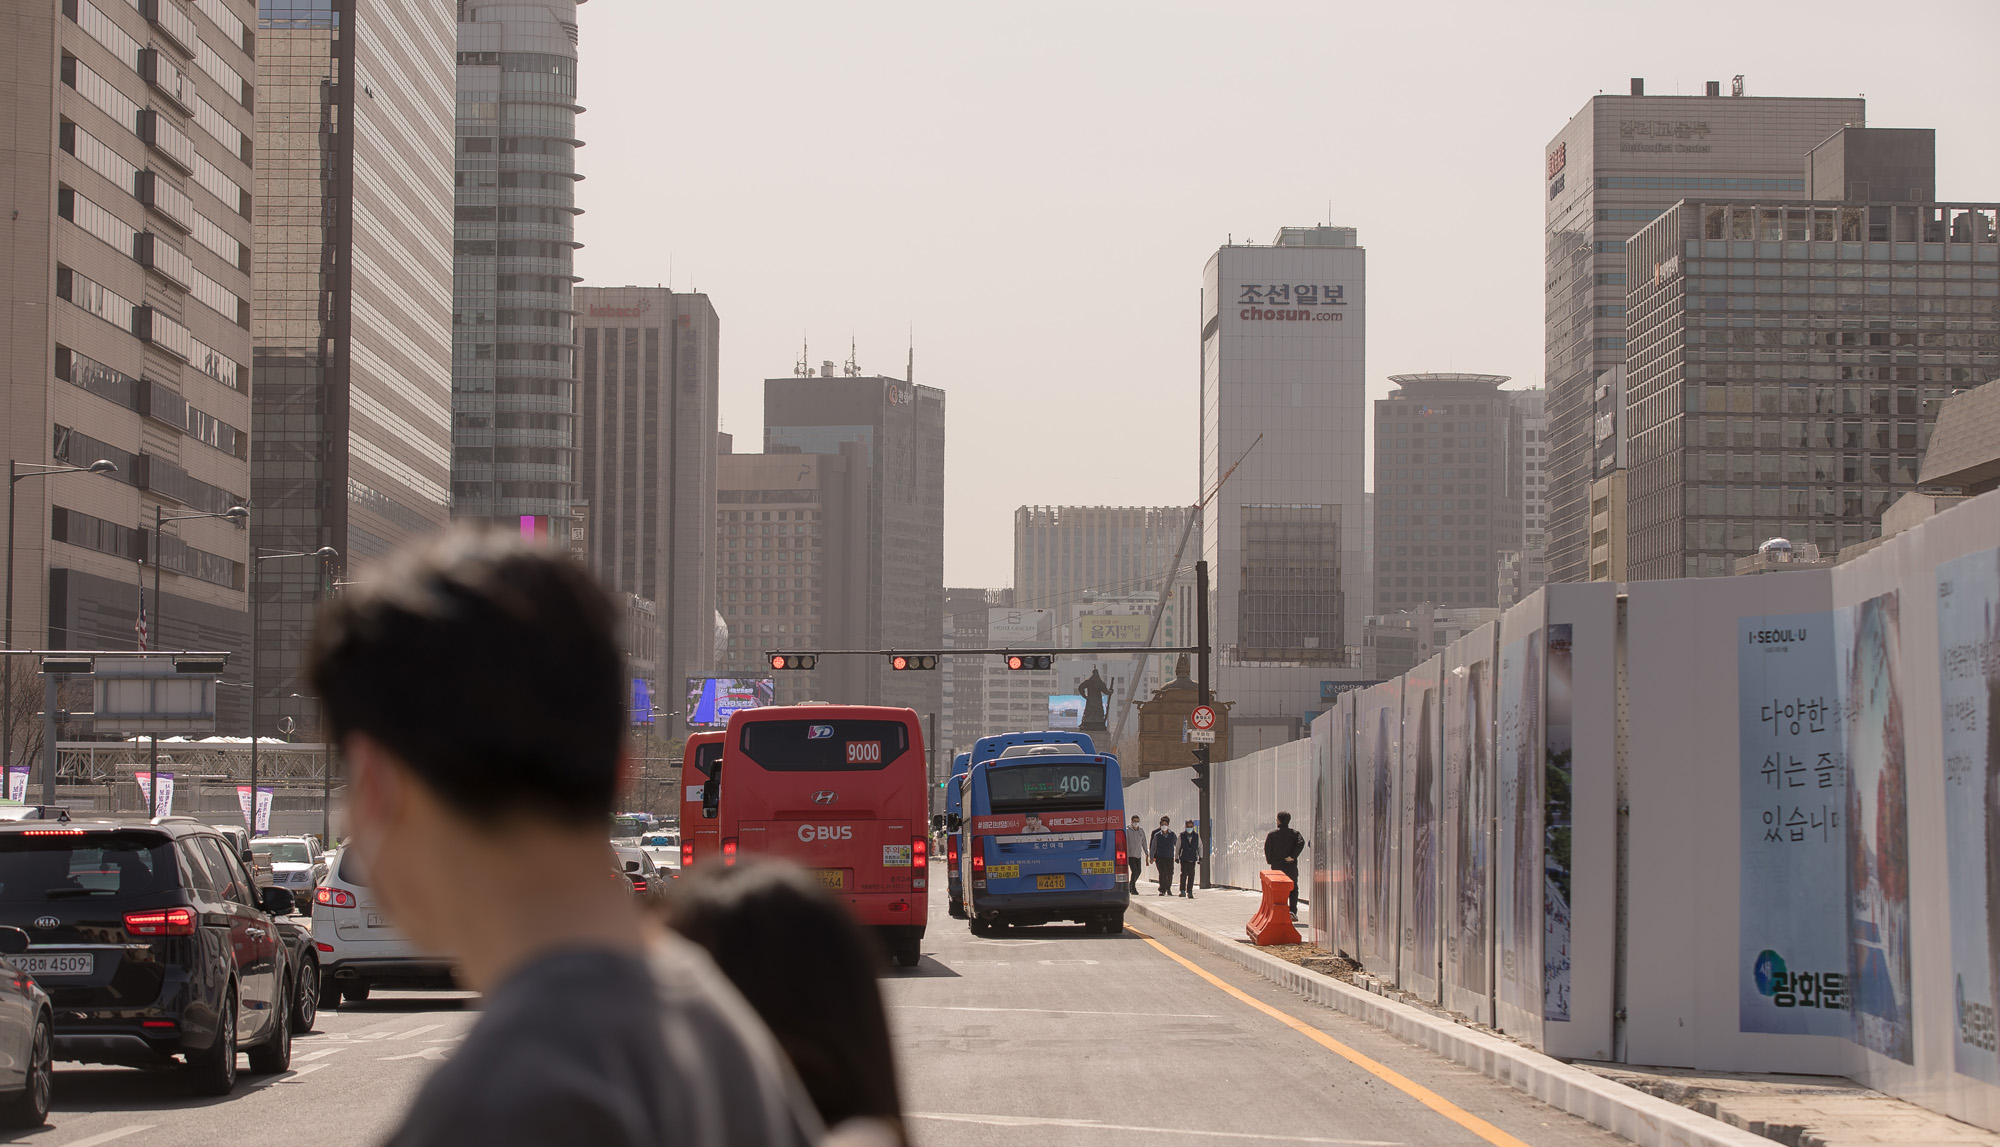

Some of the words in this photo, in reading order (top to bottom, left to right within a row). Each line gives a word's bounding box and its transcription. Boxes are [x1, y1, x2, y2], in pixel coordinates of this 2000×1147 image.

[1620, 120, 1711, 139] 감리교본부
[1620, 142, 1673, 153] Methodist
[1675, 143, 1711, 153] Center
[1238, 284, 1347, 305] 조선일보
[590, 304, 641, 318] kobaco
[1240, 306, 1343, 321] chosun.com
[1091, 625, 1120, 639] 을지
[1761, 696, 1829, 736] 다양한
[848, 743, 879, 761] 9000
[1761, 752, 1807, 789] 쉬는
[1059, 775, 1091, 792] 406
[885, 846, 900, 854] 주의
[50, 958, 86, 971] 4509
